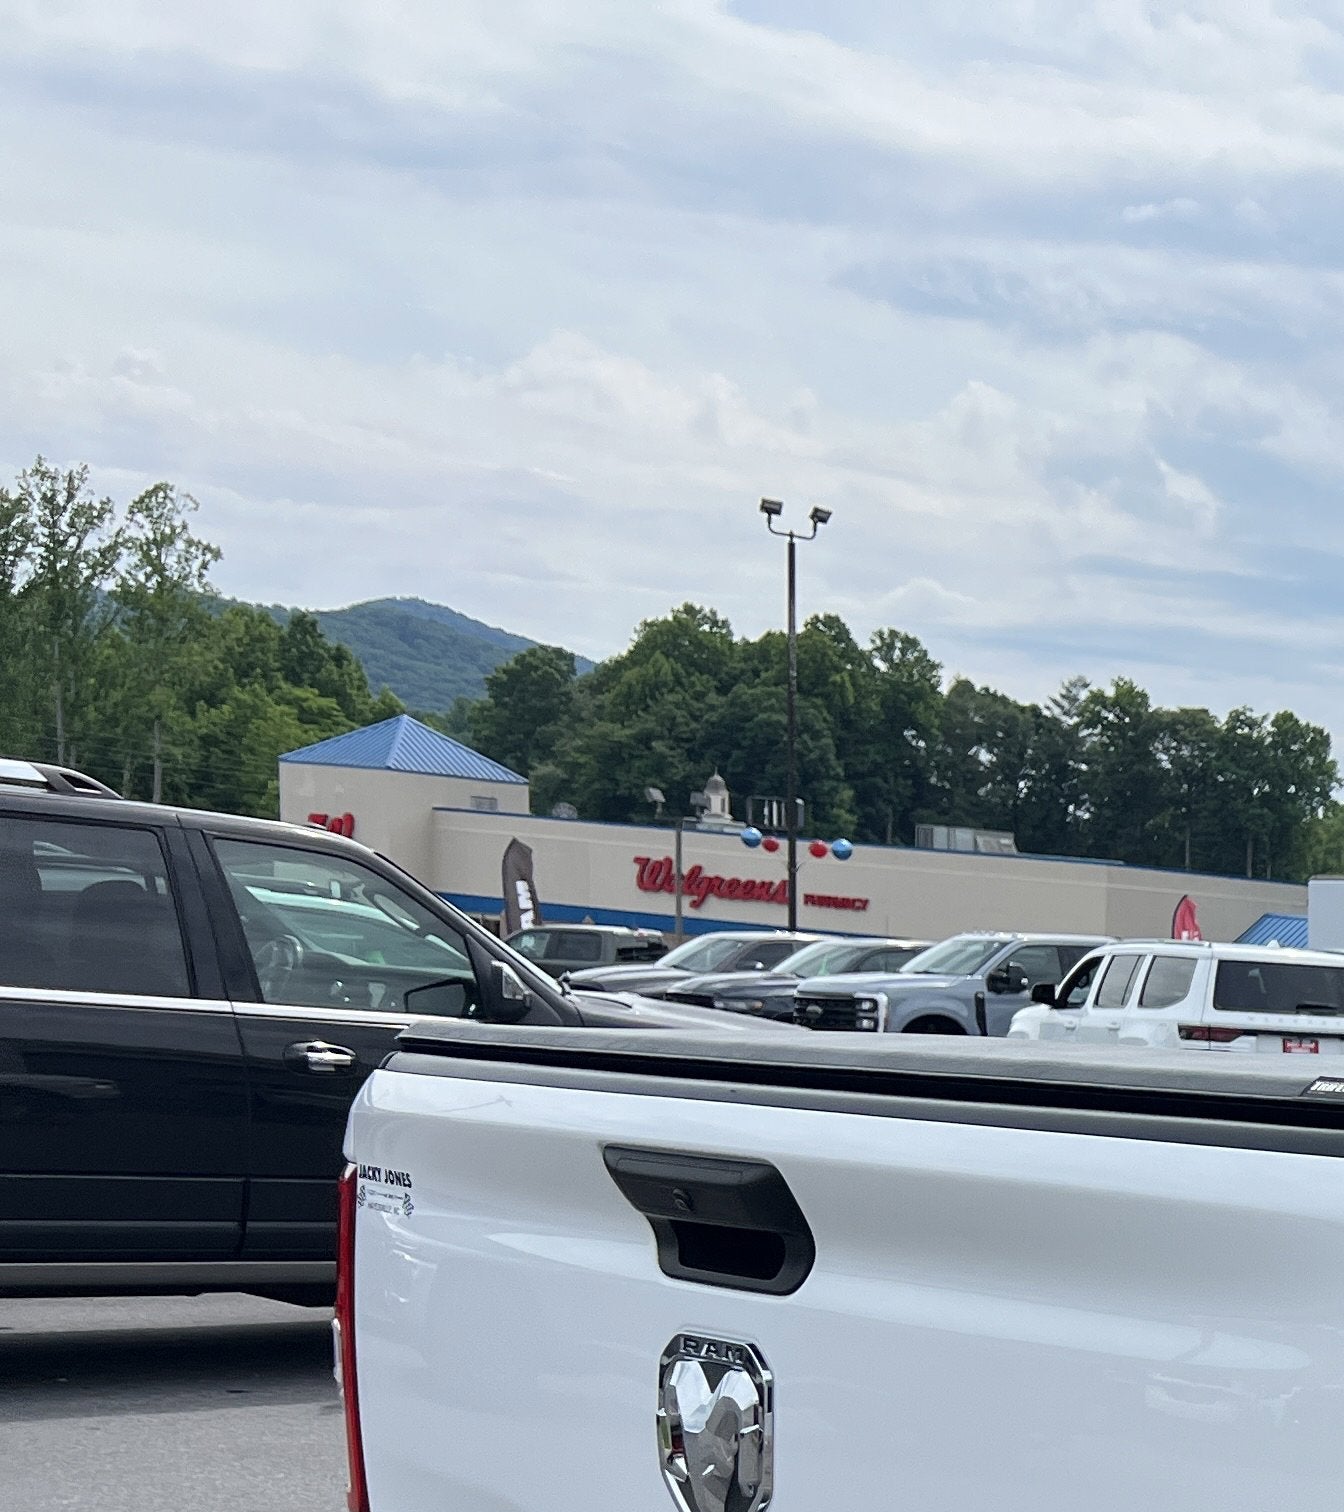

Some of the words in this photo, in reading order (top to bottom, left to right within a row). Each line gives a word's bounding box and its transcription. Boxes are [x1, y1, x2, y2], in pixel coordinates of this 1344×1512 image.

[633, 855, 789, 909] Walgreens
[515, 880, 534, 930] AM
[359, 1164, 381, 1182] JACKY
[385, 1169, 412, 1188] JONES
[679, 1337, 746, 1364] RAM
